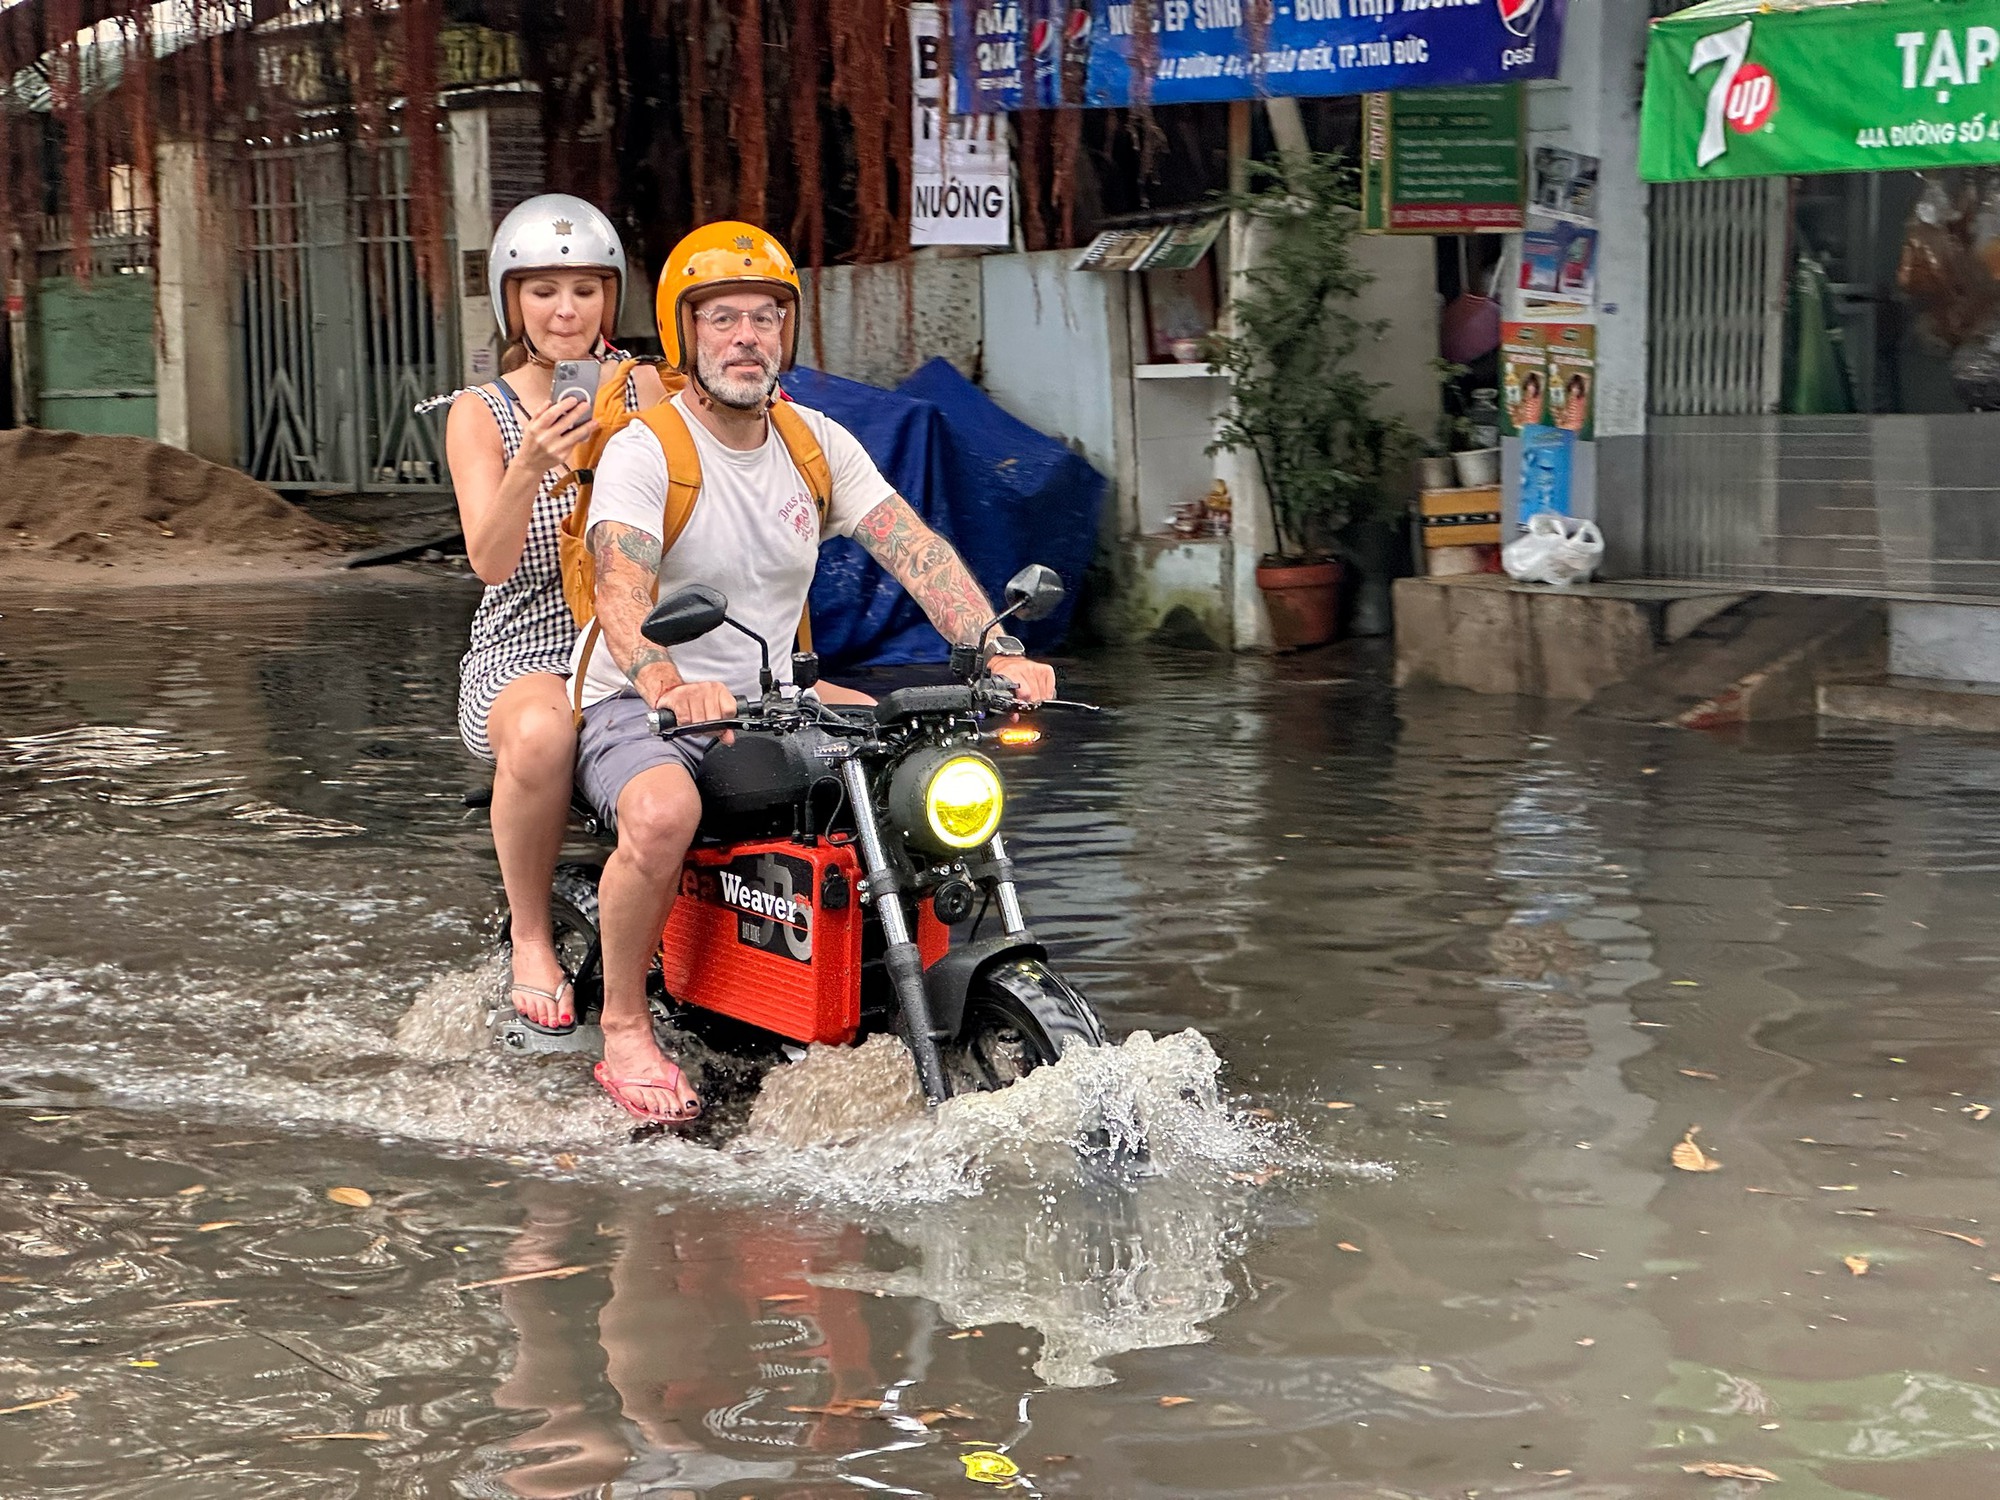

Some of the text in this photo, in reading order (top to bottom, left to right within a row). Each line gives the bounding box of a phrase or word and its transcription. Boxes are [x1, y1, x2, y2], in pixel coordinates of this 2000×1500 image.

[1895, 26, 2000, 104] TẠP
[1957, 112, 1986, 143] SỐ
[1987, 119, 2000, 141] 4
[719, 870, 798, 923] Weaver
